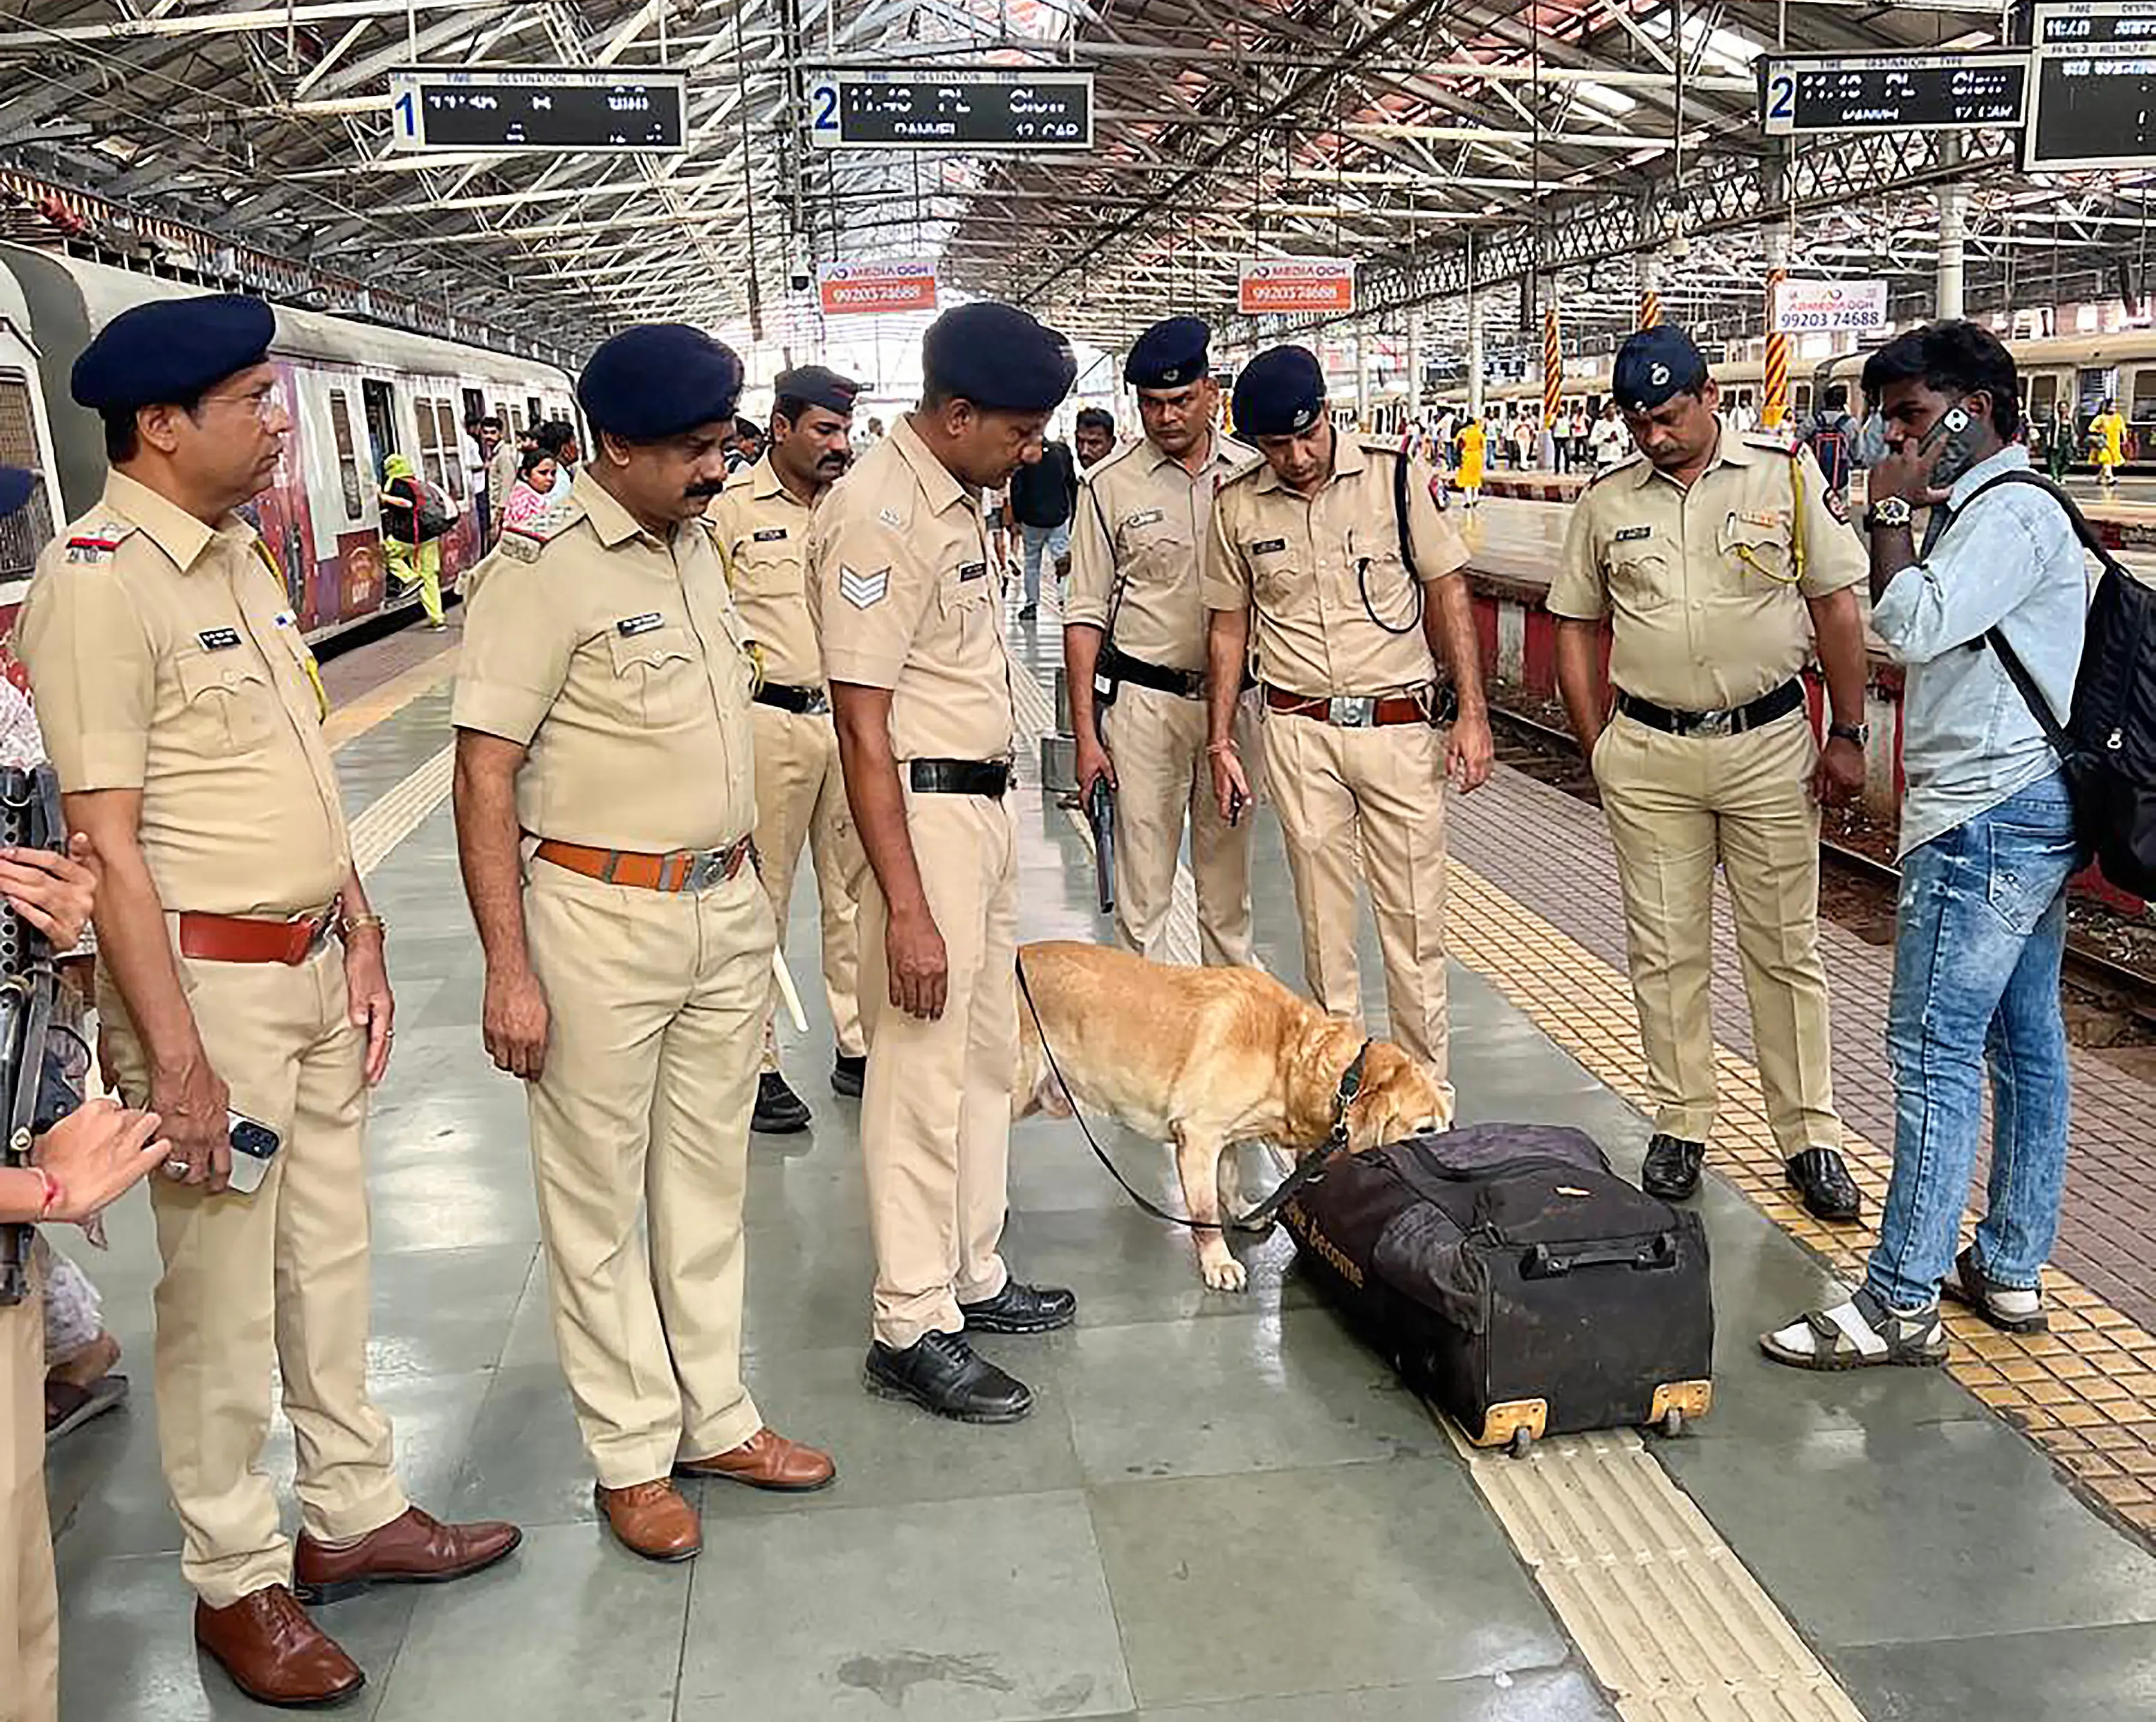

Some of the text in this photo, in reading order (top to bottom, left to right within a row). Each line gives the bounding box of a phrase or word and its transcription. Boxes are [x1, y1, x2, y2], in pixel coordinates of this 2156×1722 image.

[395, 92, 414, 137] 1
[813, 87, 838, 130] 2
[1769, 77, 1794, 119] 2
[1780, 311, 1879, 328] 99203 74688
